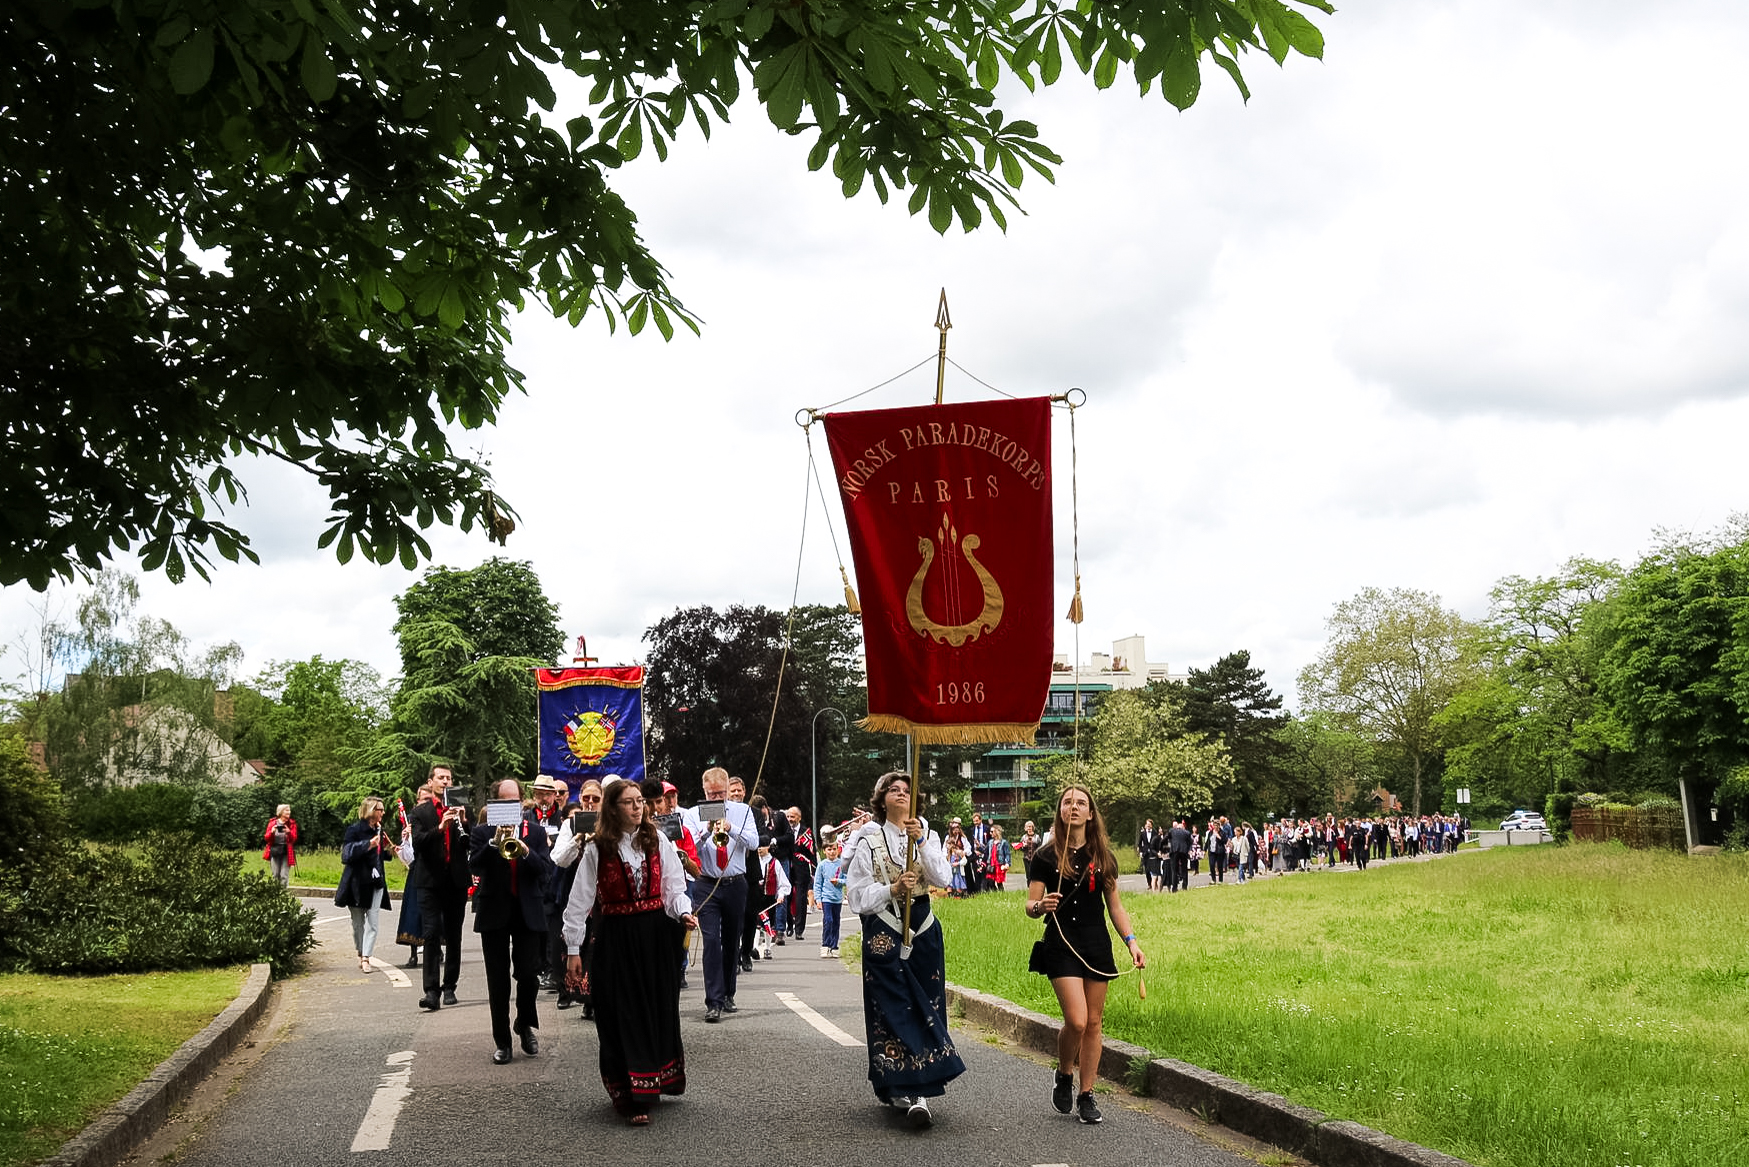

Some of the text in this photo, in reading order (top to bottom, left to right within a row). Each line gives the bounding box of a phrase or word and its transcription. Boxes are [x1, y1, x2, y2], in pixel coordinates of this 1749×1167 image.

[842, 423, 1044, 500] NORSK PARADEKORPS
[889, 476, 999, 504] PARIS
[937, 682, 985, 704] 1986
